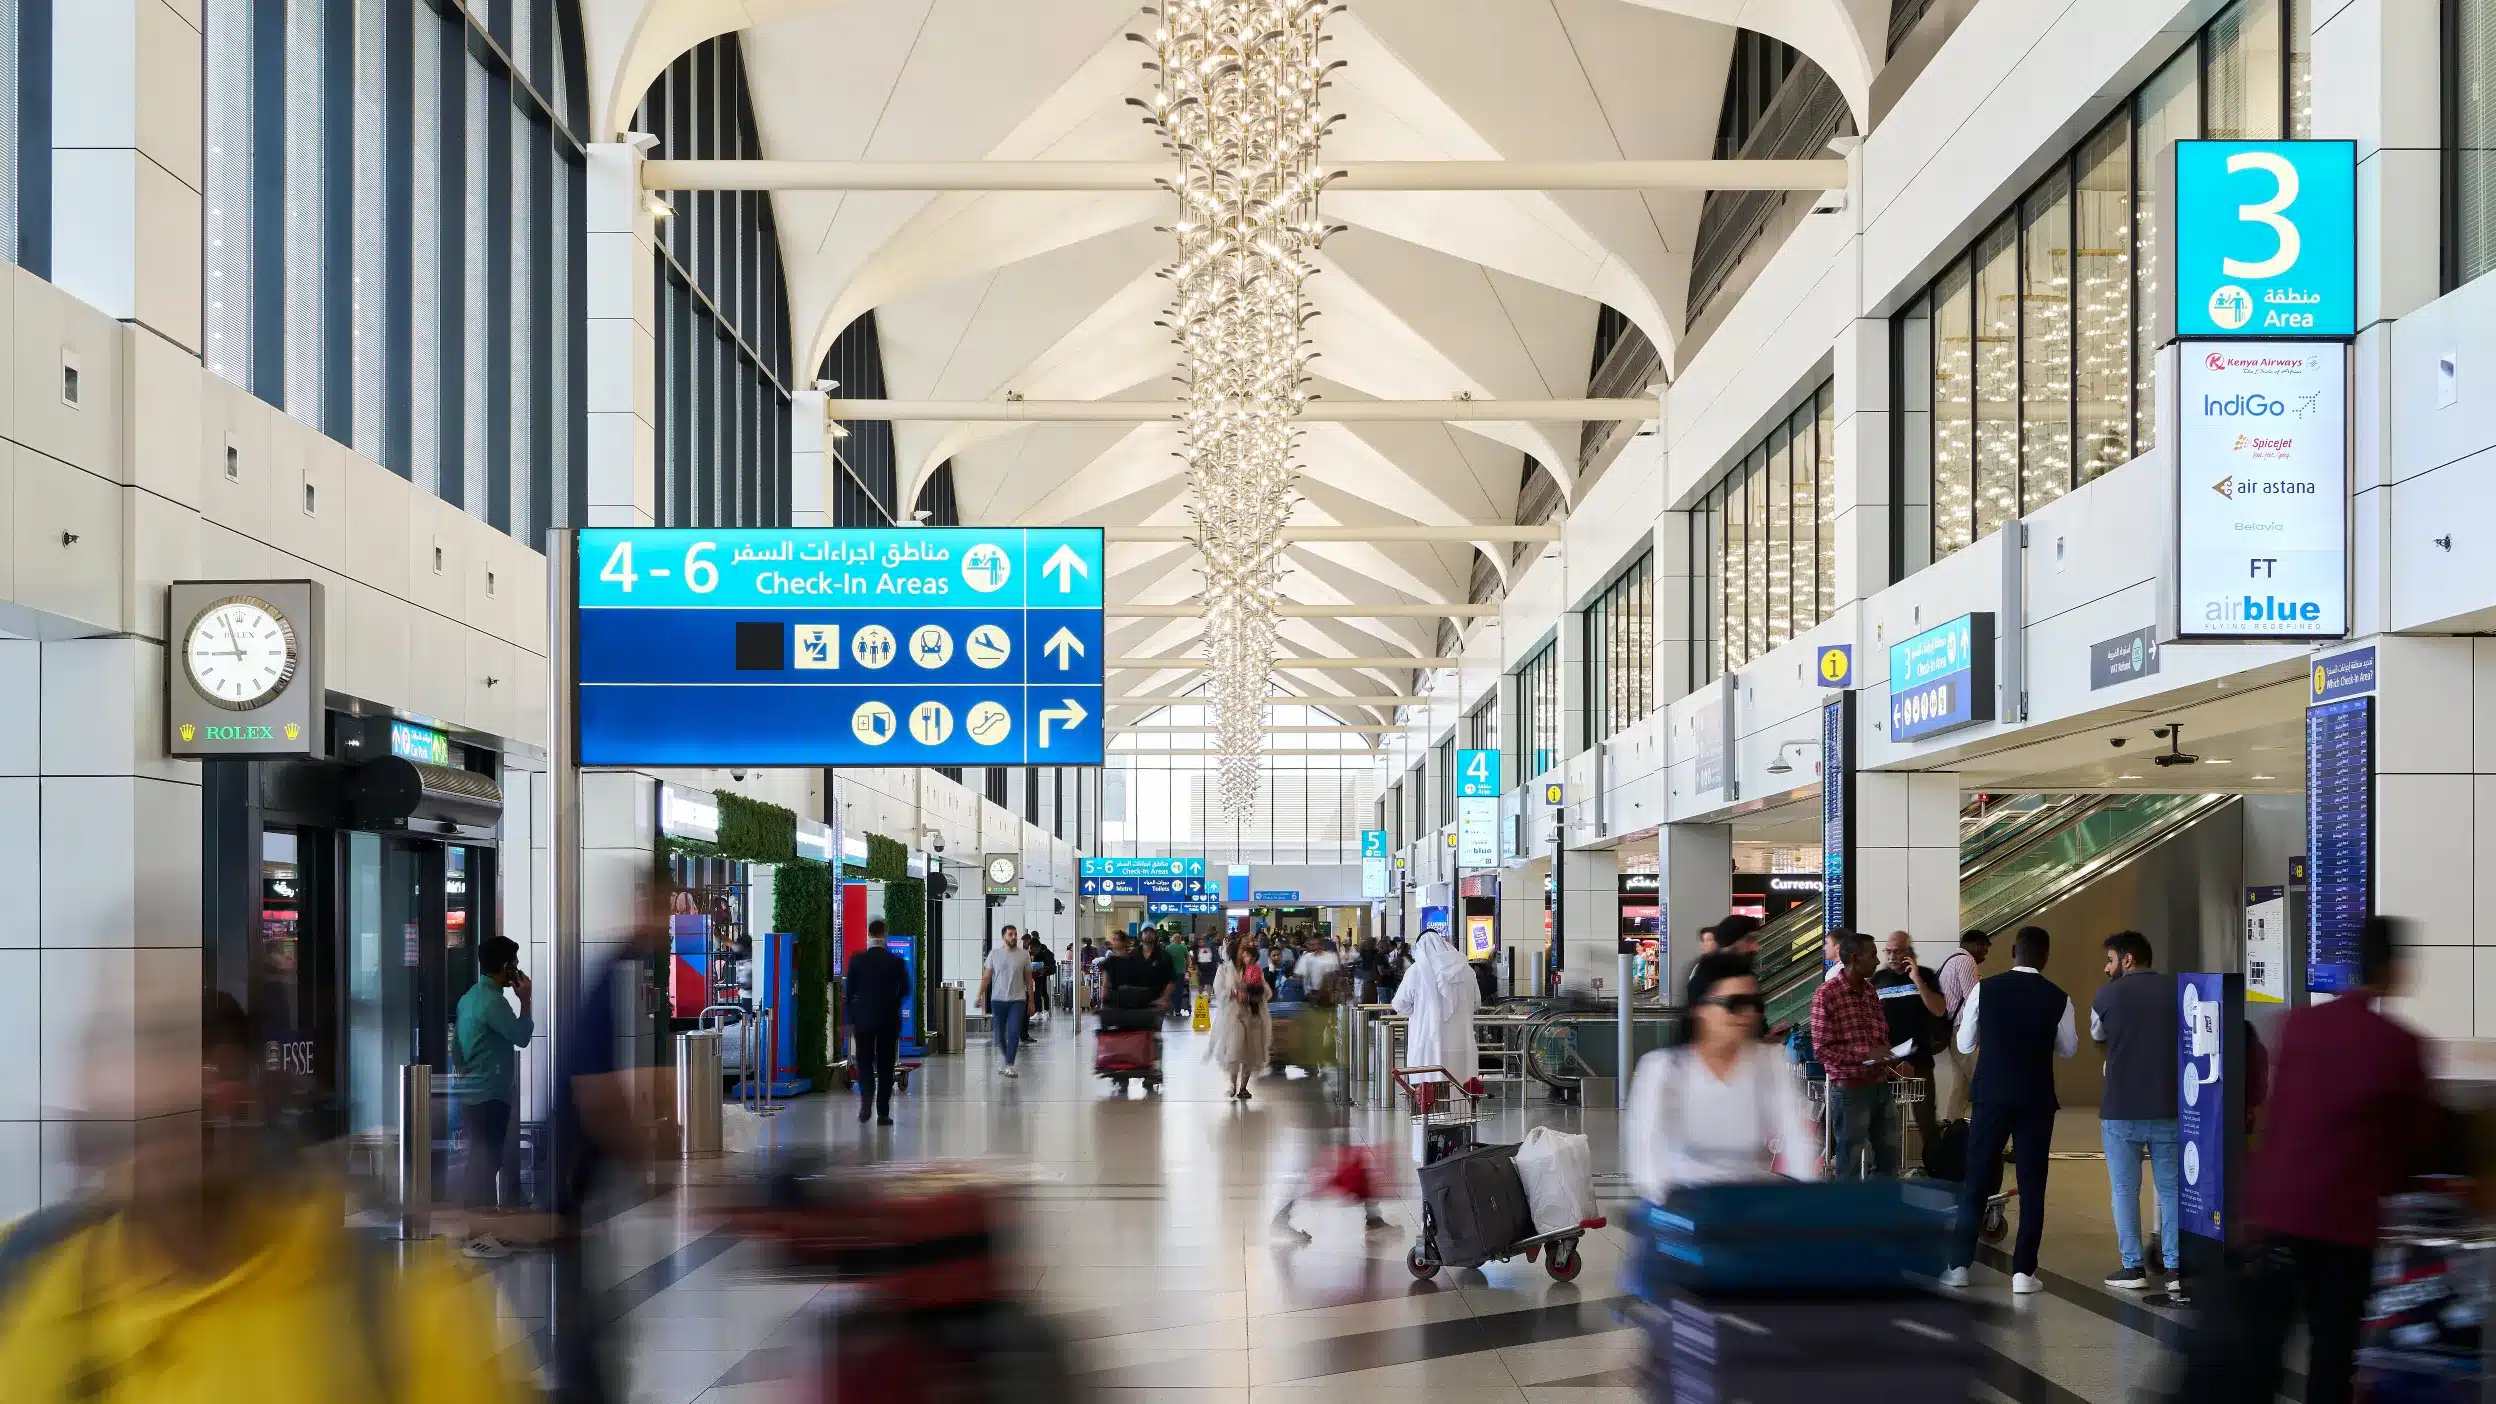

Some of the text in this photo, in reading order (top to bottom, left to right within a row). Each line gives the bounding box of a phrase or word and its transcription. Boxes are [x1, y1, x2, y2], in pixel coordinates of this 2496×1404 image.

[2222, 151, 2302, 280] 3
[2263, 288, 2321, 305] منطقة
[2263, 310, 2314, 328] Area
[2227, 358, 2303, 369] Kenya Airways
[2204, 394, 2285, 417] IndiGo
[2252, 438, 2293, 451] SpiceJet
[2237, 479, 2316, 494] air astana
[730, 540, 950, 568] مناطق اجراءات السفر
[599, 541, 639, 593] 4
[684, 541, 720, 593] 6
[2250, 558, 2278, 579] FT
[755, 571, 949, 596] Check-In Areas
[2205, 595, 2321, 621] airblue
[1904, 647, 1912, 680] 3
[2326, 670, 2374, 690] Which Check-In Area?
[204, 725, 275, 741] ROLEX
[1466, 751, 1490, 783] 4
[1368, 831, 1380, 850] 5
[1085, 860, 1095, 874] 5
[1104, 860, 1114, 874] 6
[1770, 878, 1824, 892] Currency
[1291, 892, 1298, 900] 6
